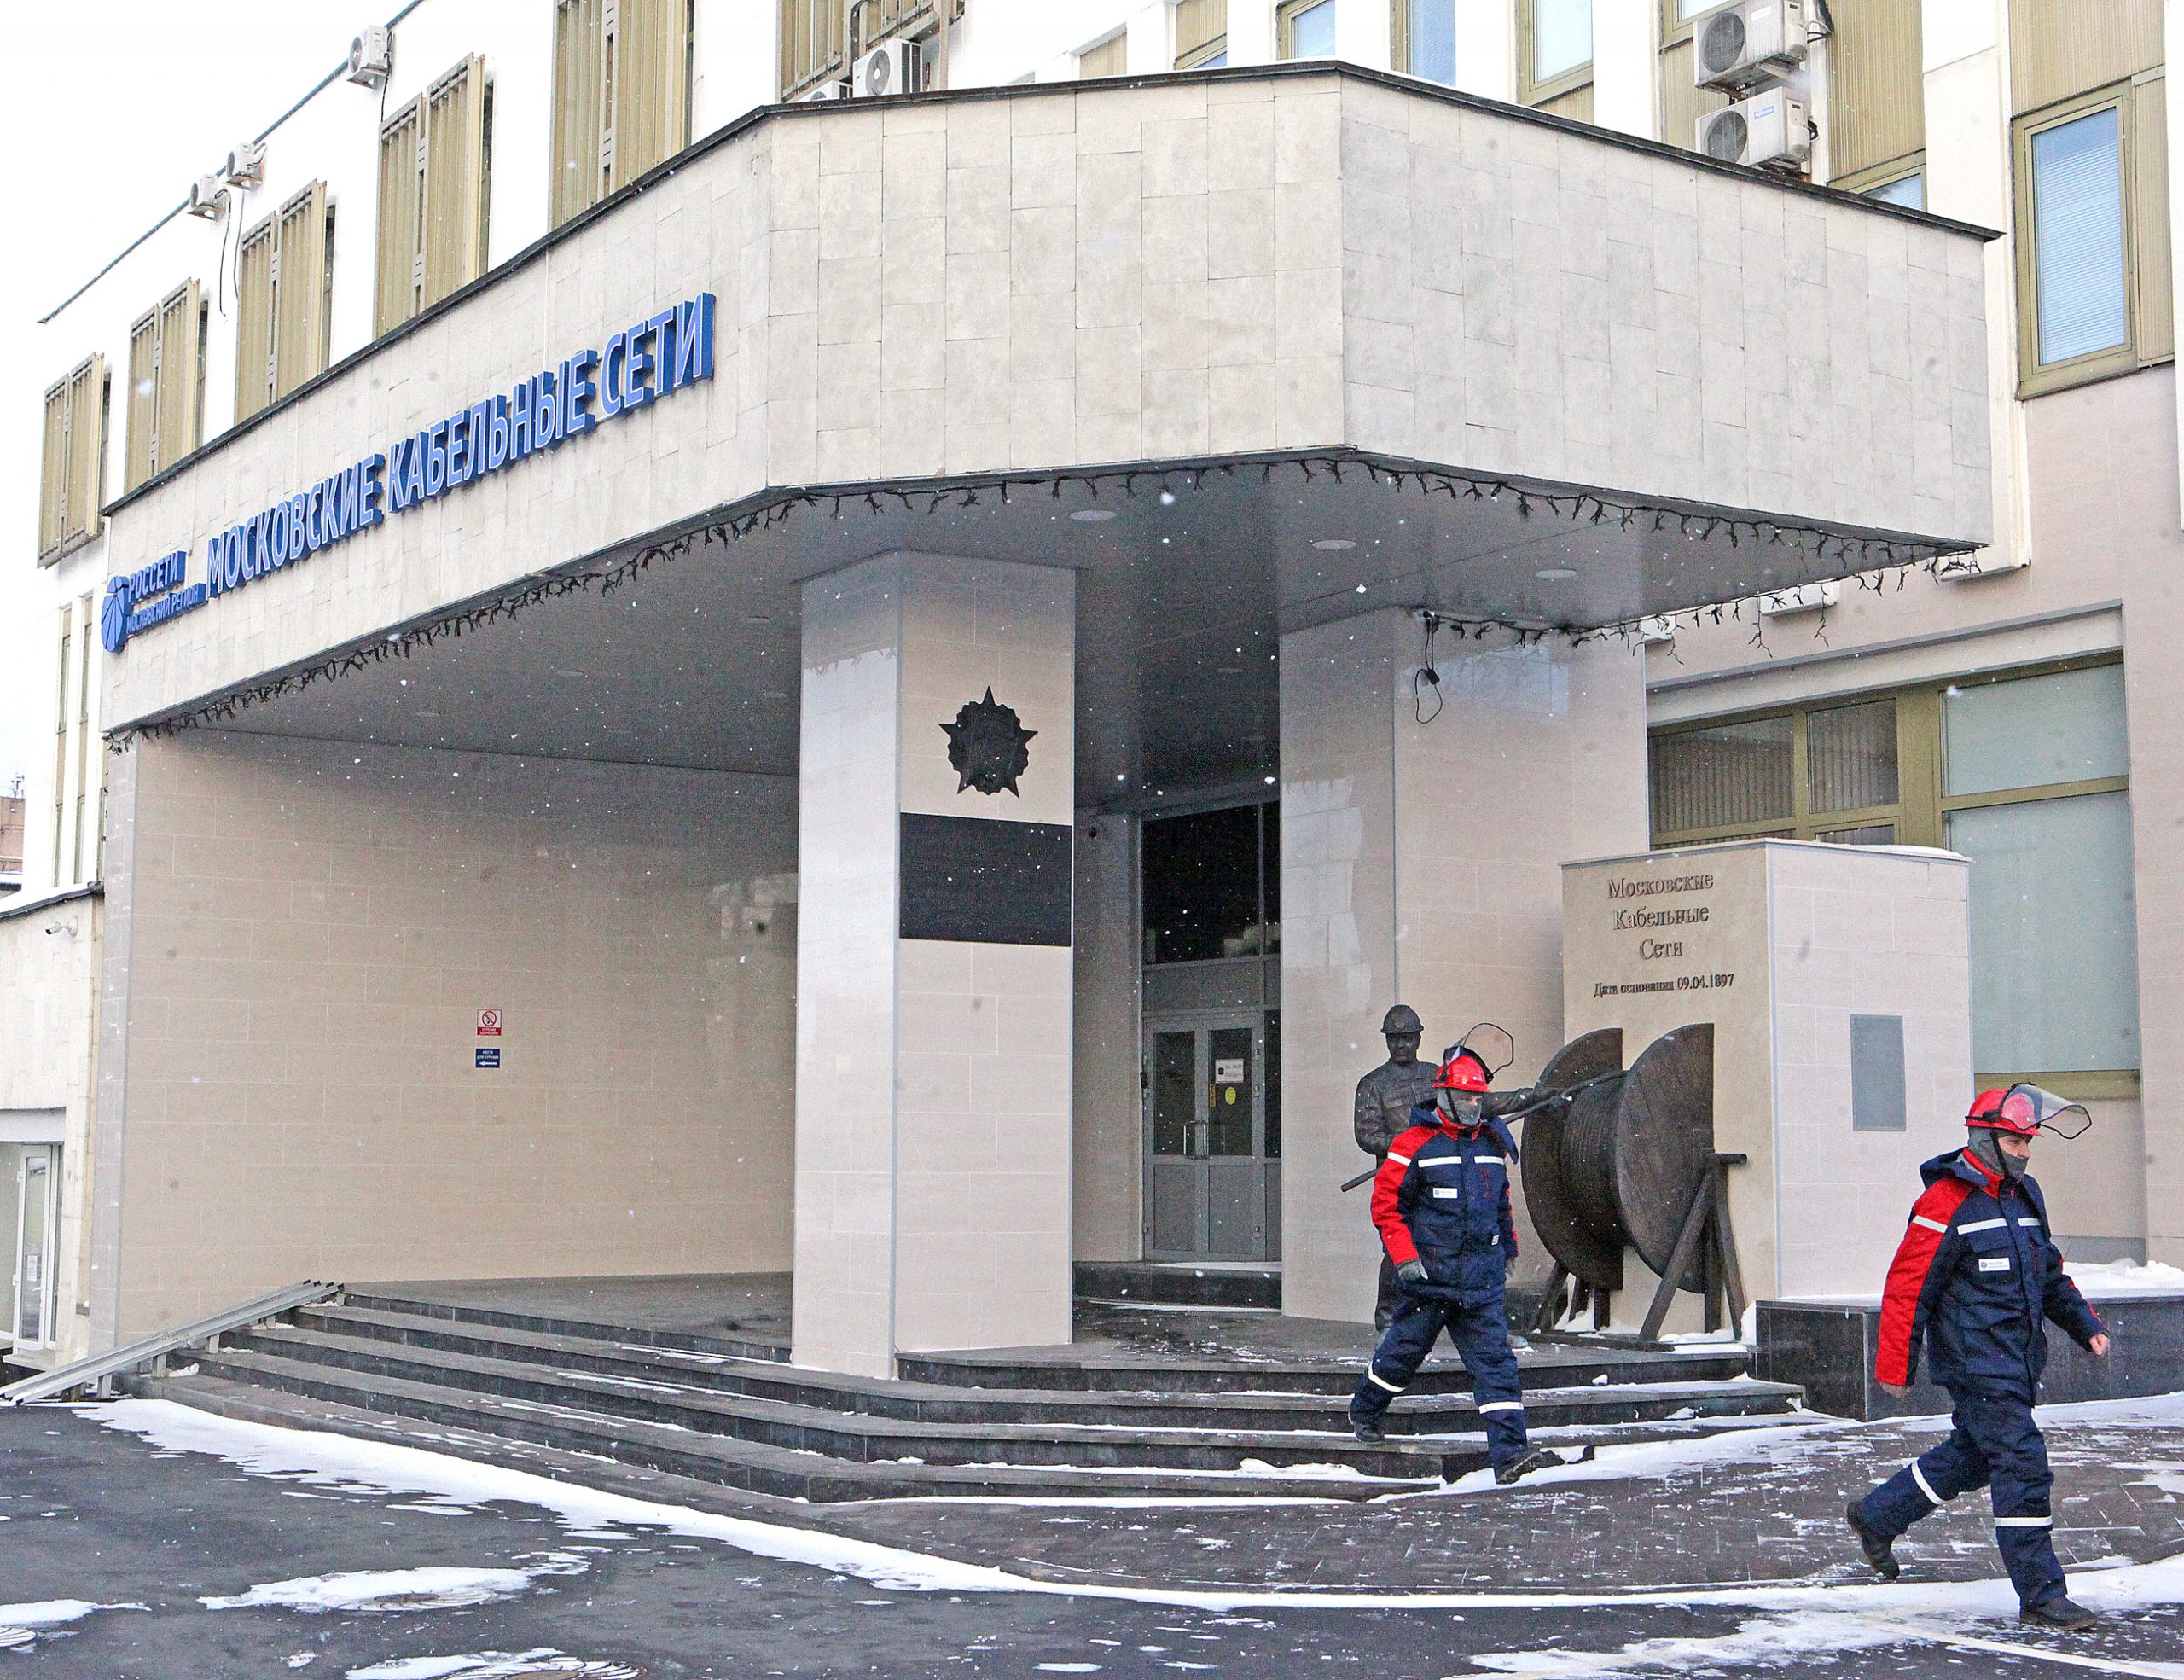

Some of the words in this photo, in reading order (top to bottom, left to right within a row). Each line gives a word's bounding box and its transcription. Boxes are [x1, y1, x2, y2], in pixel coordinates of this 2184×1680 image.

[206, 454, 384, 597] МОСКОВСКИЕ
[387, 350, 597, 513] КАБЕЛЬНЫЕ
[601, 292, 716, 416] СЕТИ
[128, 550, 185, 604] РОССЕТИ
[1607, 873, 1714, 898] Московские
[1613, 905, 1709, 930] Кабельные
[1639, 939, 1683, 960] Сети
[1594, 982, 1618, 998] Дата
[1677, 974, 1734, 990] 09.04.1897
